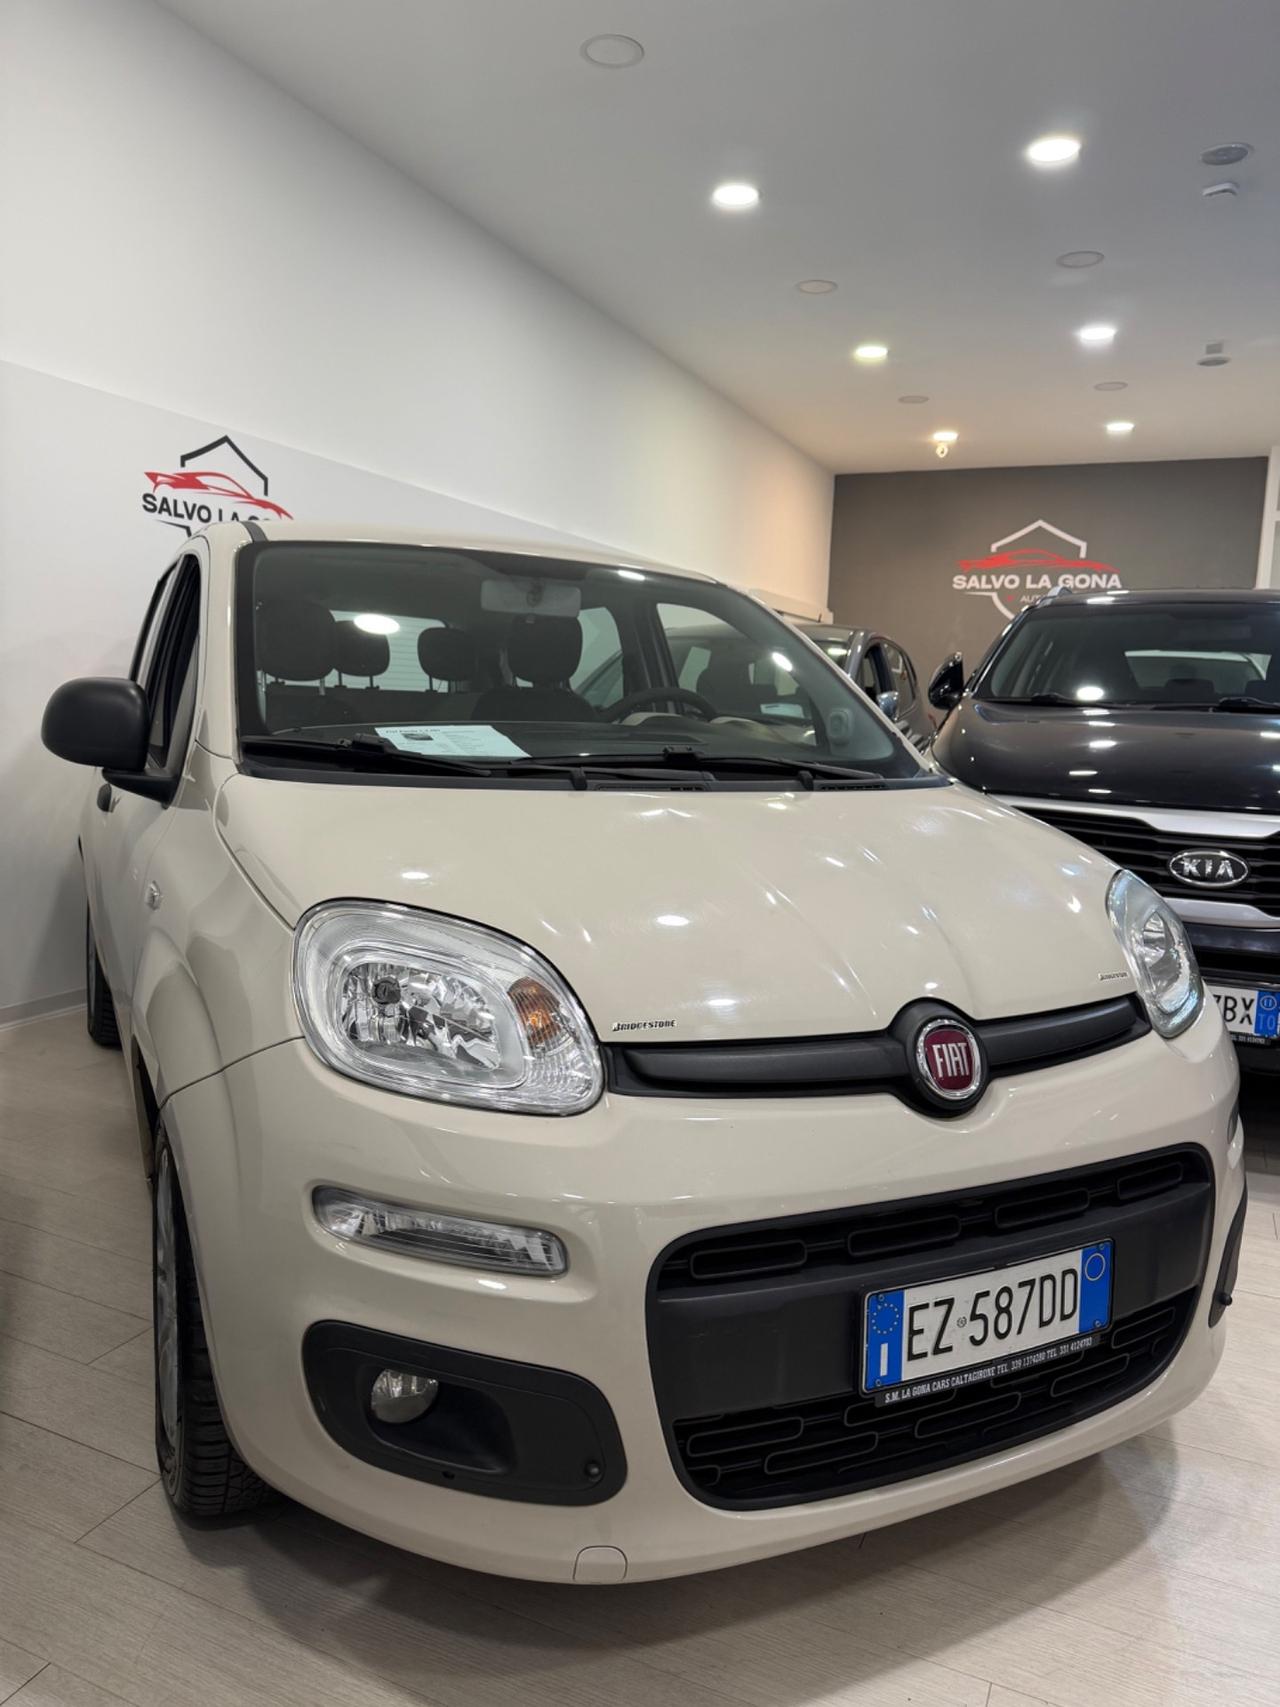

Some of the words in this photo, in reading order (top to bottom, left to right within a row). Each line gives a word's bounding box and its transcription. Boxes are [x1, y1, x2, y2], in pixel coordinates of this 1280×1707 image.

[142, 493, 212, 523] SALVO
[952, 574, 1020, 589] SALVO
[1025, 574, 1052, 589] LA
[1058, 573, 1122, 589] GONA
[1182, 857, 1235, 879] KIA
[932, 1042, 970, 1078] FIAT
[901, 1389, 912, 1399] LA
[912, 1383, 932, 1397] GONA
[931, 1378, 951, 1392] CARS
[951, 1366, 996, 1387] CALTAGIRONE
